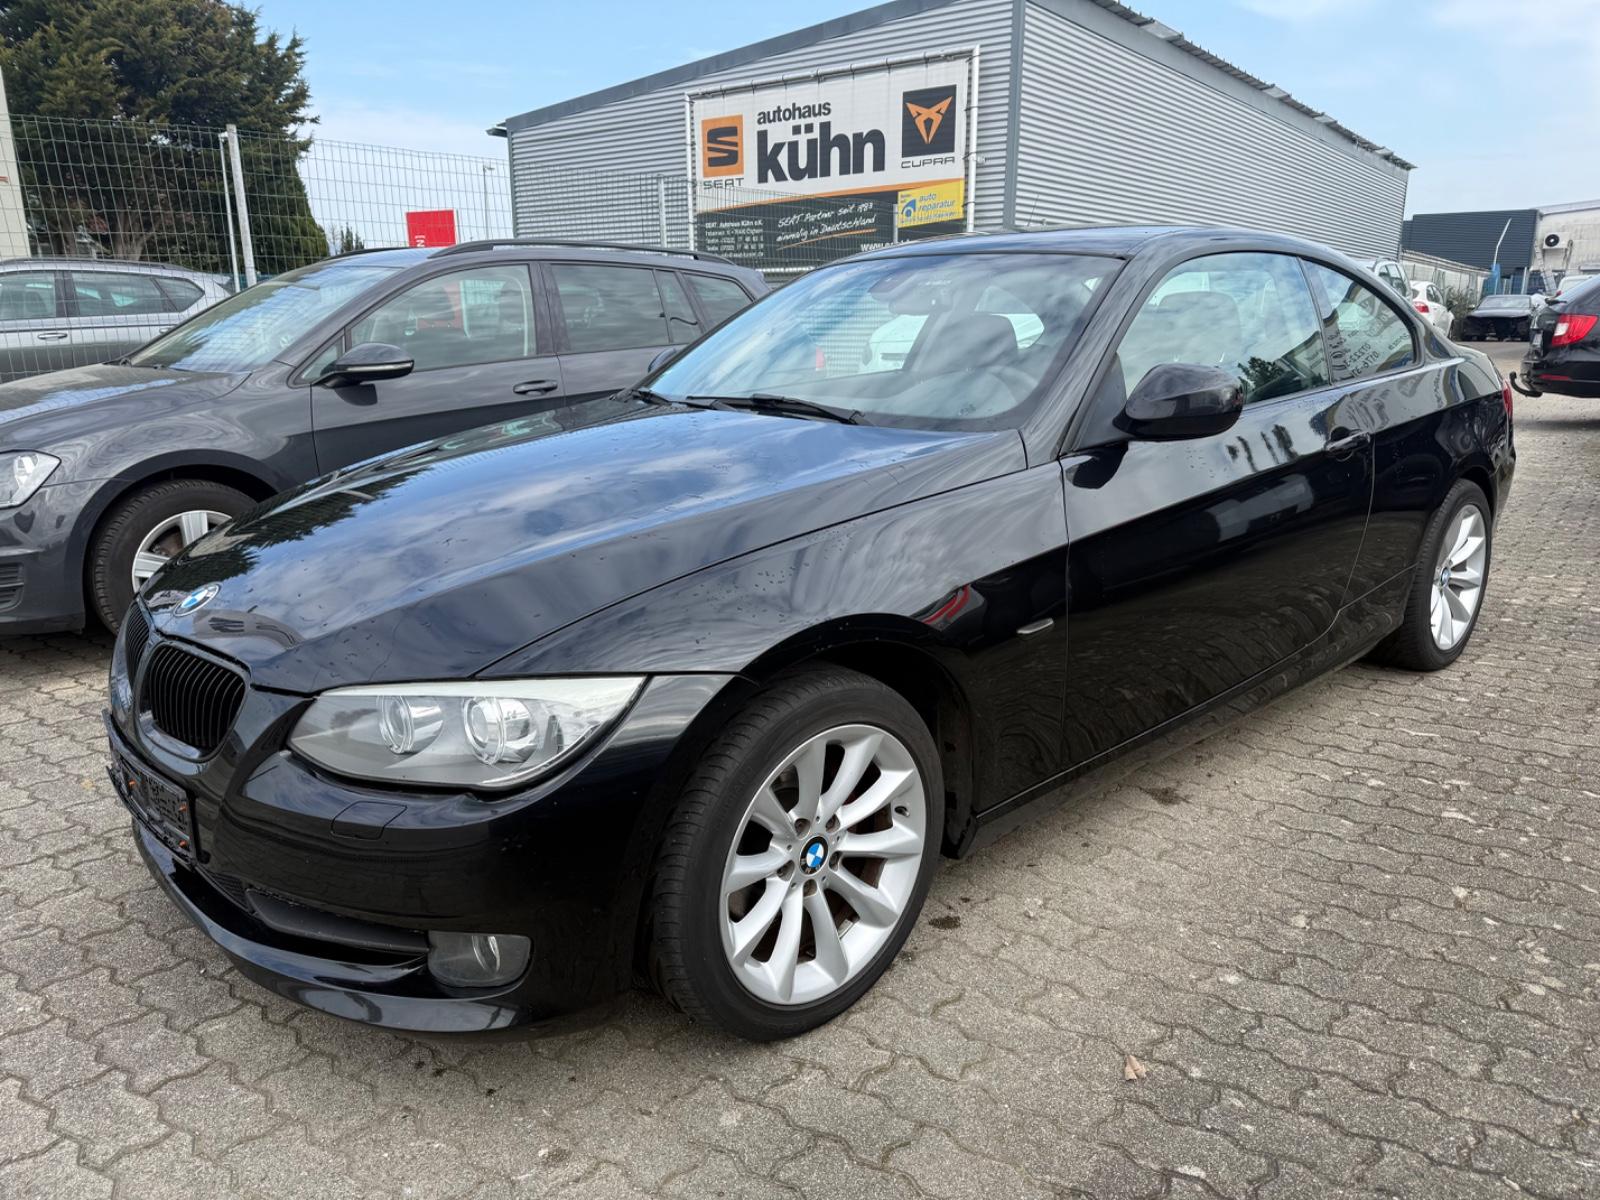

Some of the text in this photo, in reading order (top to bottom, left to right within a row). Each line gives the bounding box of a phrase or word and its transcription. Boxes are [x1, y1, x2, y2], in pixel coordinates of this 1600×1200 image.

[757, 102, 832, 125] autohaus
[757, 121, 886, 184] kühn
[901, 156, 956, 169] CUPRA
[703, 177, 744, 190] SEAT
[777, 213, 804, 228] SEAT
